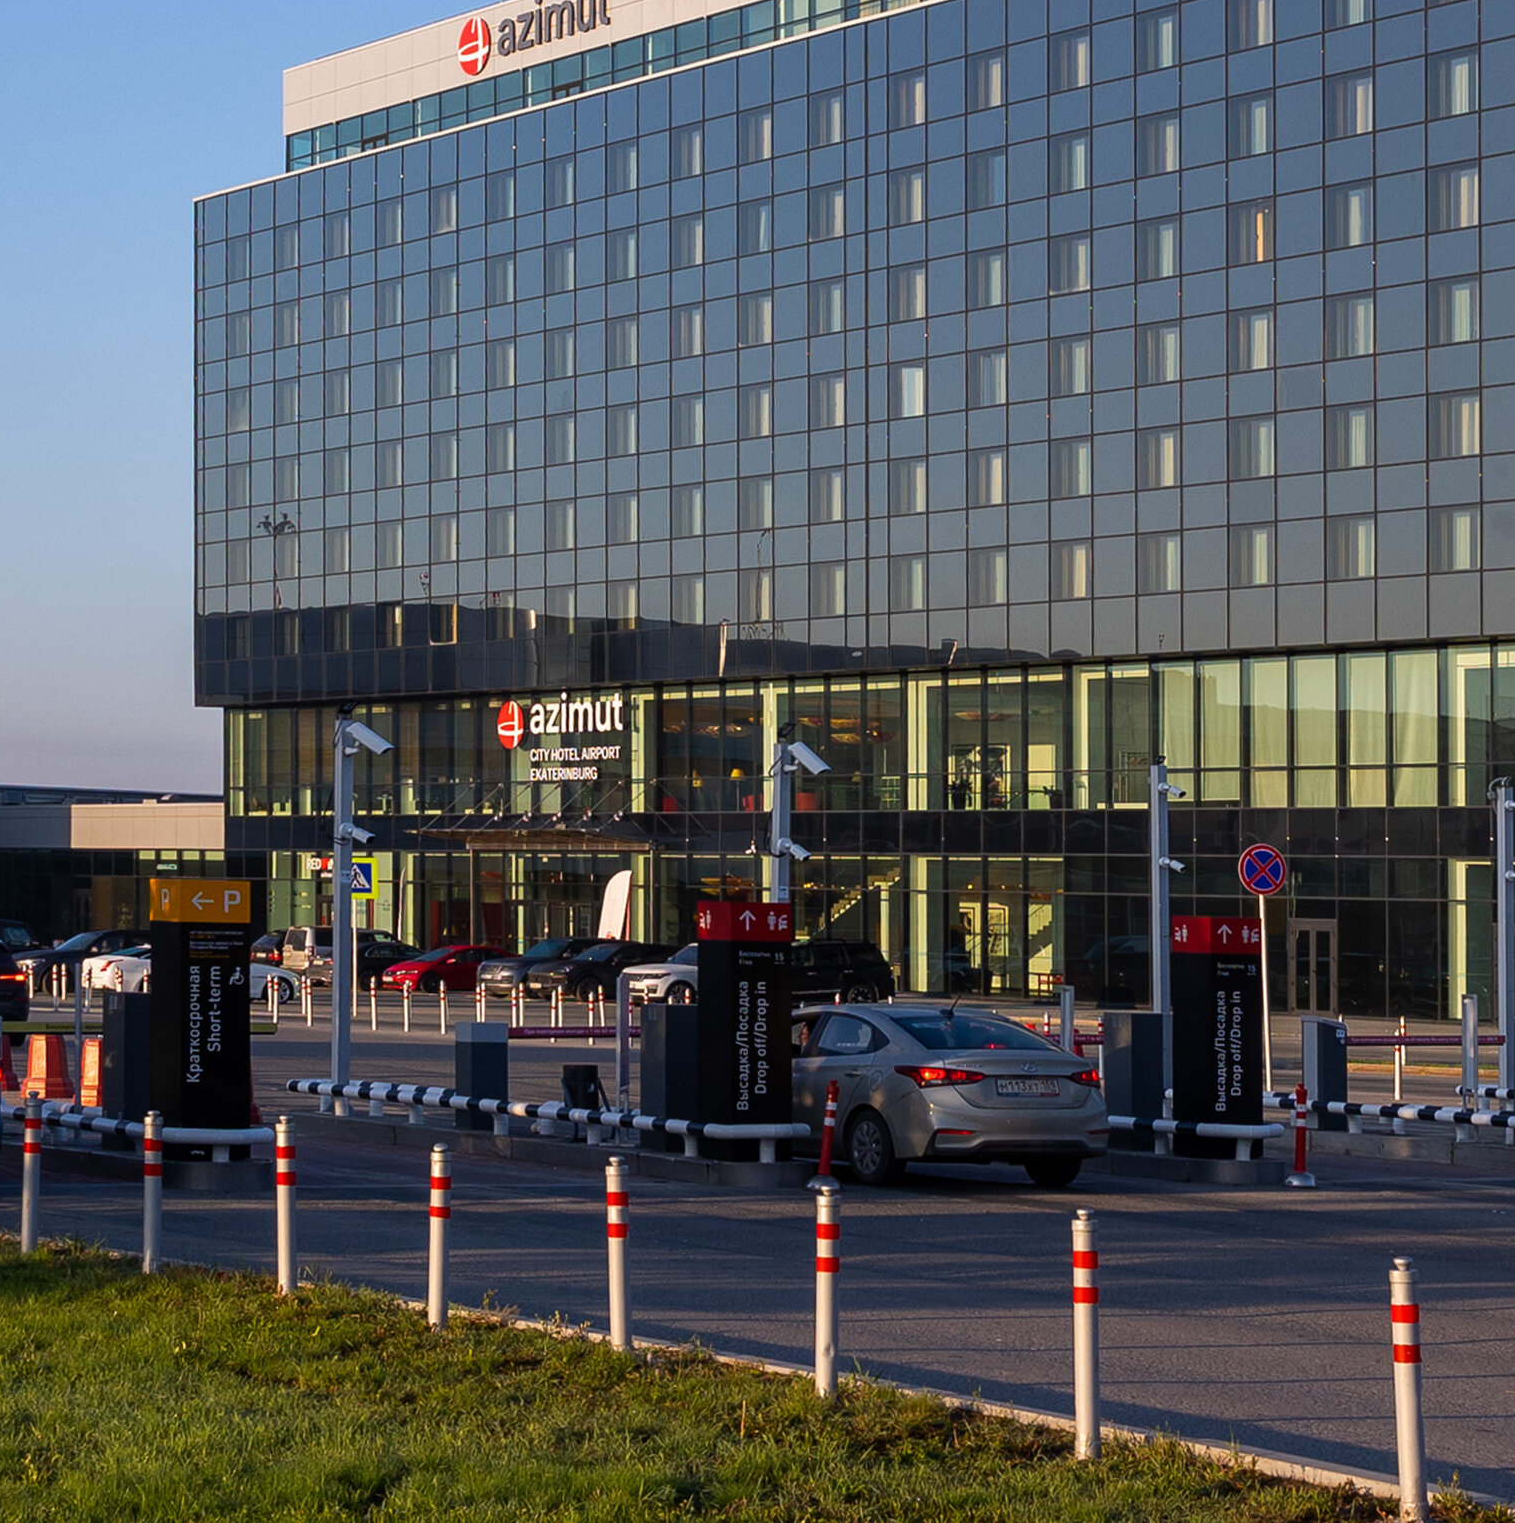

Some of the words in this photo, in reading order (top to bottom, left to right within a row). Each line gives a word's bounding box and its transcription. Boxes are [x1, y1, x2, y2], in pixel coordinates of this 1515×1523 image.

[530, 692, 623, 735] azimut
[530, 748, 551, 762] CITY
[551, 747, 580, 761] HOTEL
[581, 746, 621, 760] AIRPORT
[530, 766, 598, 781] EKATERINBURG
[223, 890, 241, 913] P
[754, 981, 767, 994] in
[1230, 991, 1241, 1003] in
[186, 966, 203, 1083] Краткосрочная
[207, 966, 221, 1052] Short-term
[753, 998, 769, 1057] off/Drop
[735, 981, 750, 1111] Высадка/Посадка
[1214, 991, 1228, 1111] Высадка/Посадка
[1230, 1006, 1243, 1061] off/Drop
[754, 1061, 769, 1094] Drop
[1231, 1065, 1243, 1096] Drop
